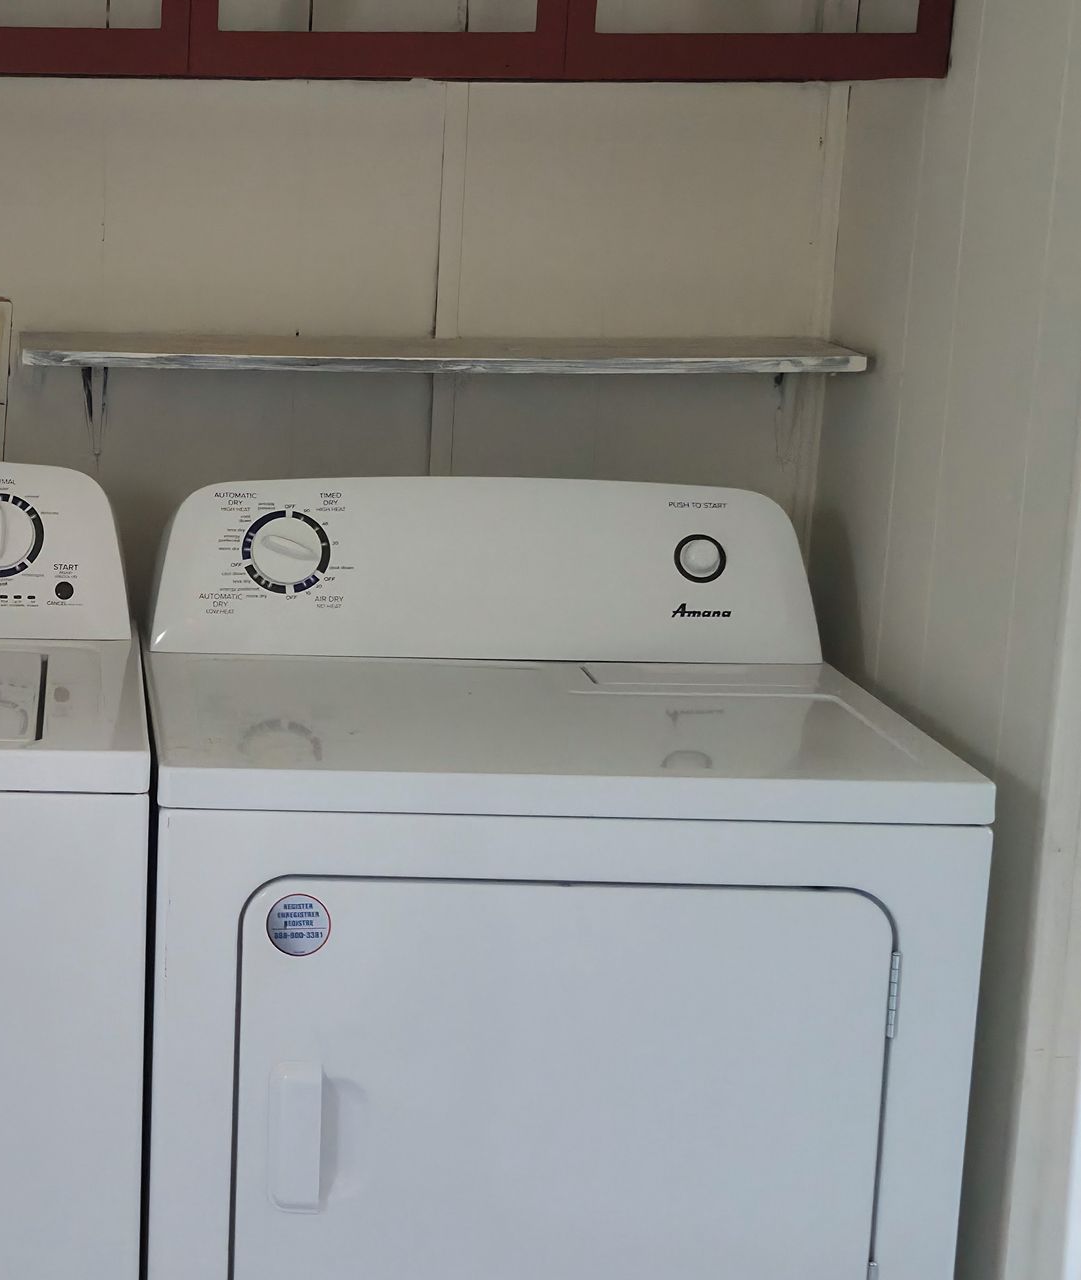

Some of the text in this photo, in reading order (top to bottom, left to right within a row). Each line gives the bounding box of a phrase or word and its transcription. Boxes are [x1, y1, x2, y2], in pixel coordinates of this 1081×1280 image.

[53, 563, 79, 571] START
[671, 603, 732, 618] Amana
[277, 911, 320, 919] ENREGISTRER
